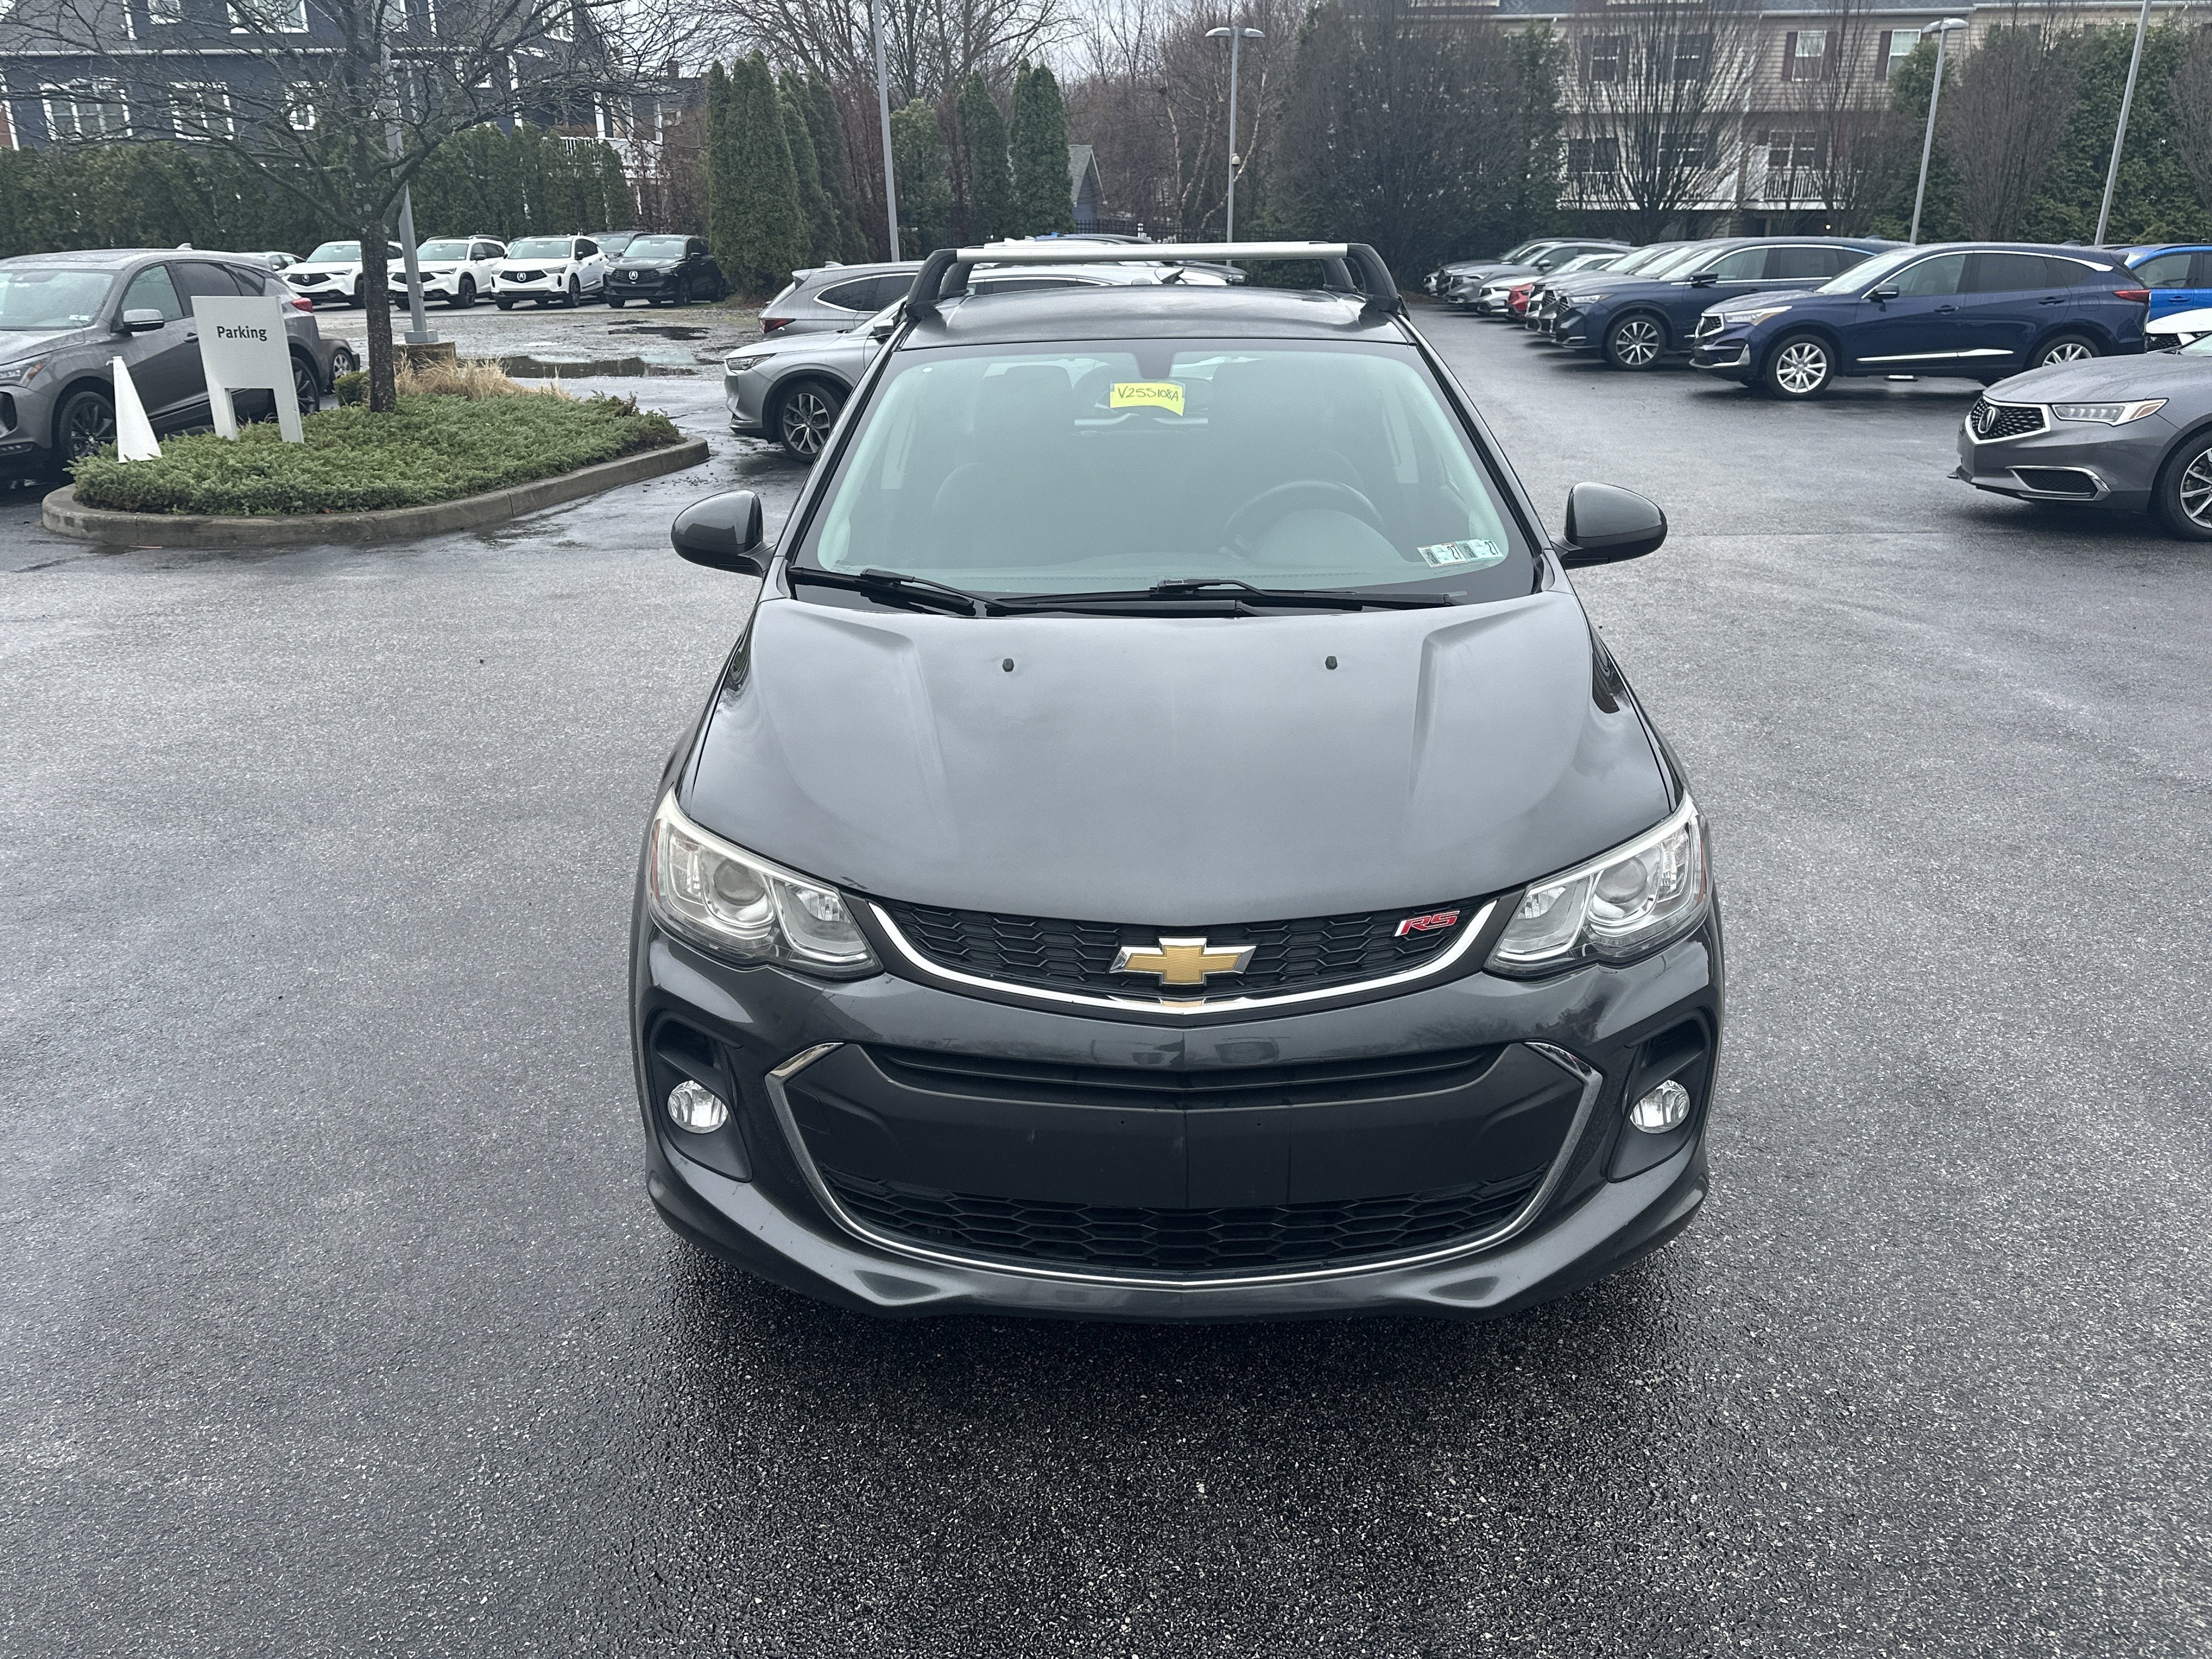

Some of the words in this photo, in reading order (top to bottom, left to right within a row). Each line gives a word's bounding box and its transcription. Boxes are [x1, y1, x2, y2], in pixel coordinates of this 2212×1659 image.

[217, 326, 267, 341] Parking
[1447, 544, 1462, 560] 27
[1484, 540, 1499, 555] 27
[1395, 911, 1460, 936] RS
